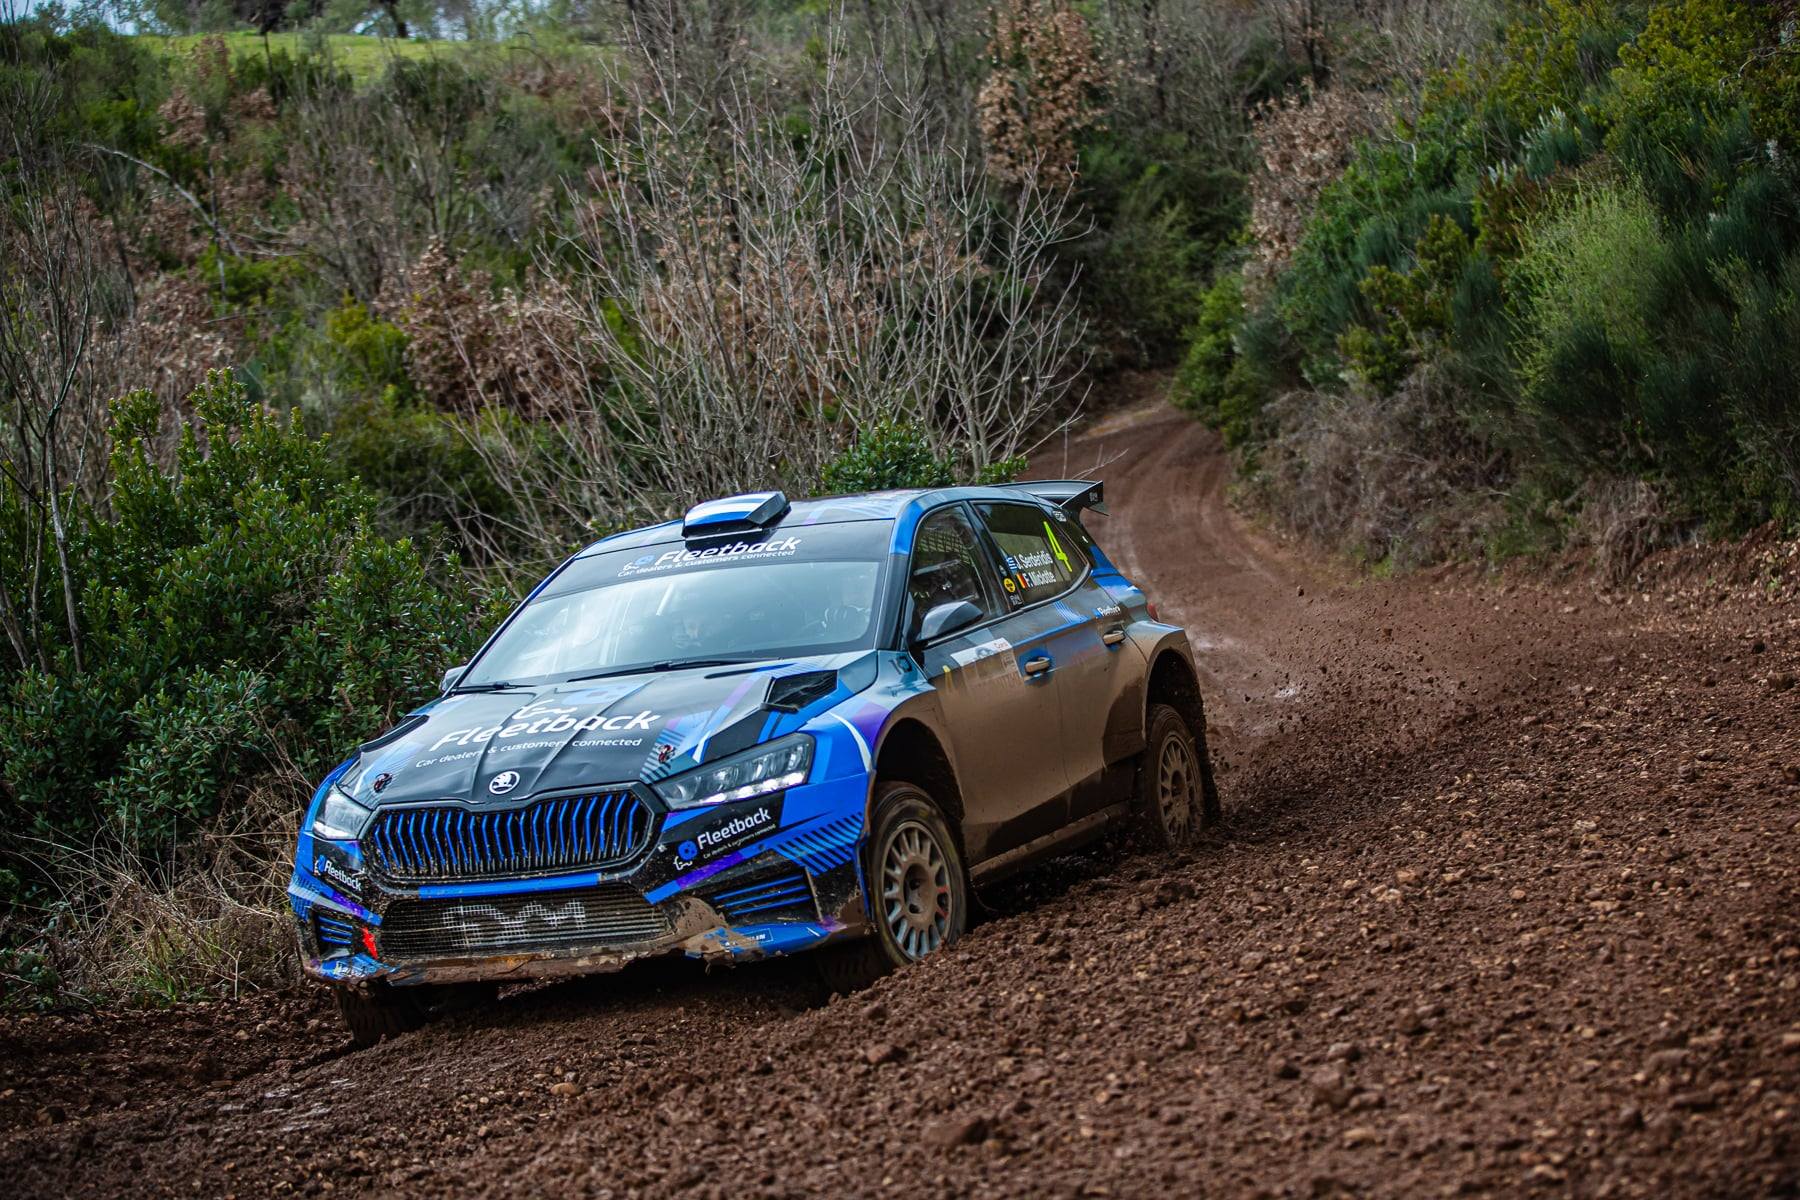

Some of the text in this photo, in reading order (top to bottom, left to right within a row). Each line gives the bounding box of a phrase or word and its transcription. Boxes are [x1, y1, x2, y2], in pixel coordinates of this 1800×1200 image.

[617, 568, 634, 577] Car
[685, 554, 740, 567] customers
[740, 550, 795, 560] connected
[655, 536, 802, 566] Fleetback
[1043, 521, 1072, 573] 4
[428, 710, 662, 752] Fleetback
[415, 758, 438, 768] Car
[571, 738, 643, 747] connected
[697, 807, 772, 850] Fleetback
[324, 859, 362, 892] Fleetback
